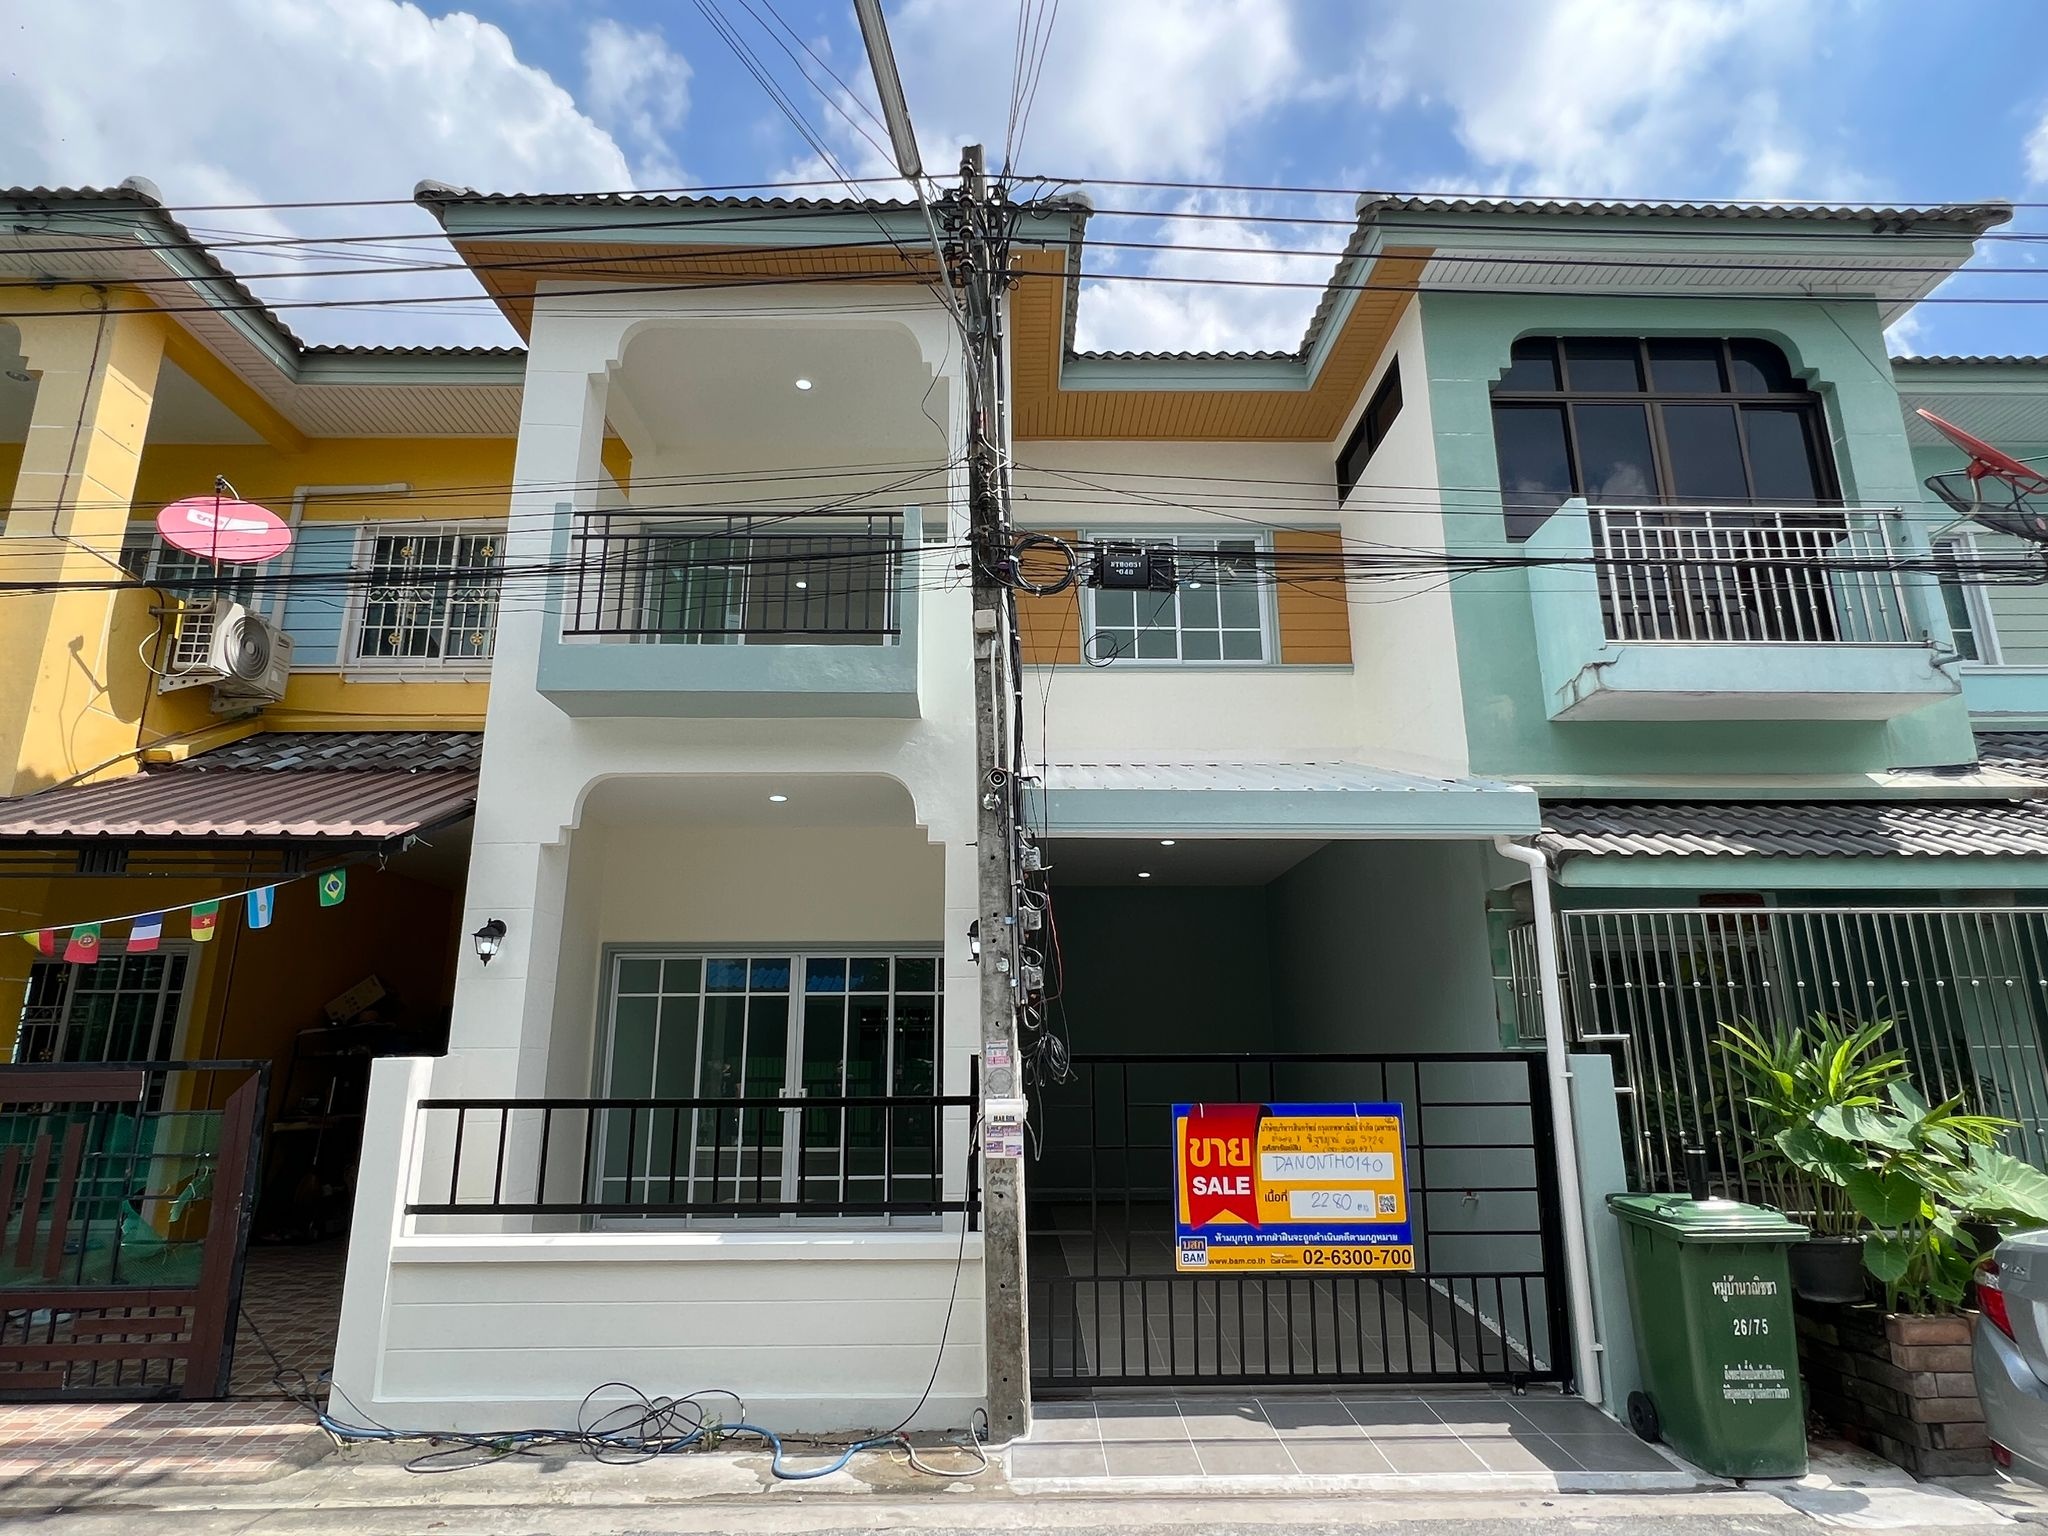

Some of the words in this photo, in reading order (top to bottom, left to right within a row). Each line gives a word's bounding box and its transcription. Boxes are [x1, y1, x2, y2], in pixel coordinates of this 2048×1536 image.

[1189, 1138, 1250, 1167] ขาย
[1192, 1176, 1250, 1196] SALE
[1264, 1189, 1288, 1203] เนื้อที่
[1215, 1232, 1253, 1245] ห้ามบุกรุก
[1182, 1253, 1205, 1264] BAM
[1209, 1256, 1266, 1265] www.bam.co.th
[1303, 1249, 1411, 1265] 02-6300-700
[1733, 1319, 1769, 1335] 26/75
